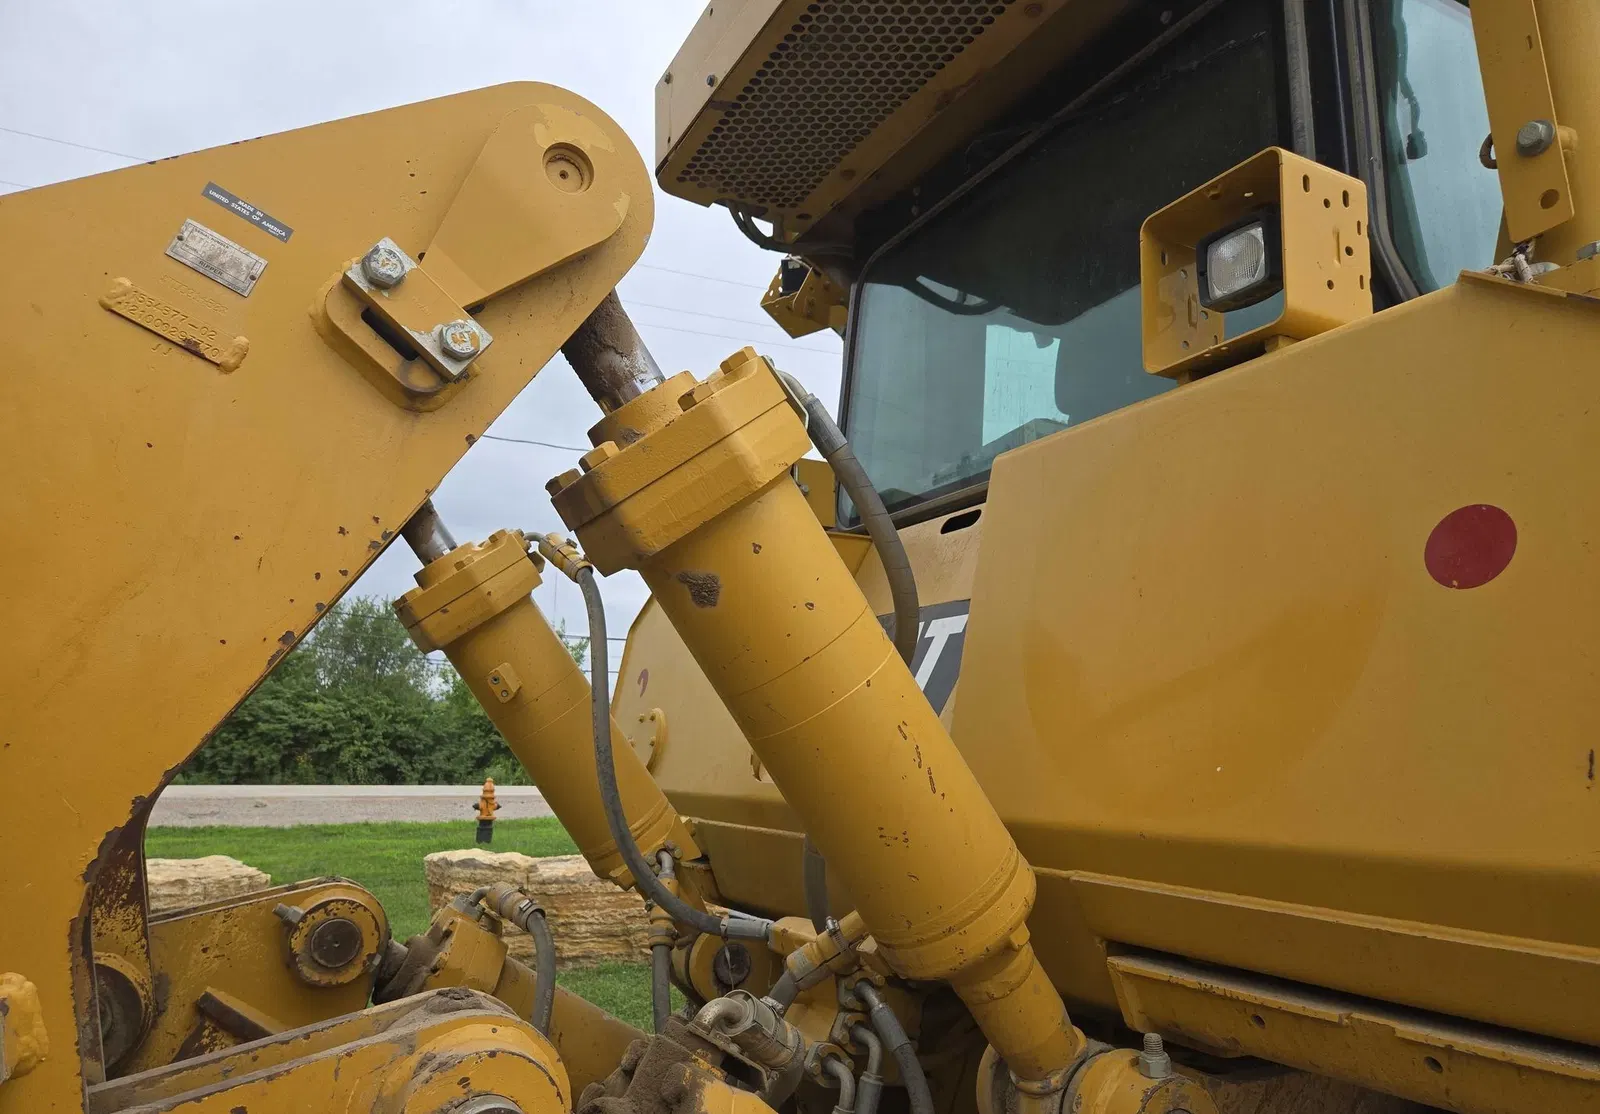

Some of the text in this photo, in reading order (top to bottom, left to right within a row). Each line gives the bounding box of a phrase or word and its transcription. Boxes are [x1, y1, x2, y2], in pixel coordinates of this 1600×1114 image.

[208, 189, 229, 204] UNITED
[230, 202, 251, 217] STATES
[251, 214, 261, 222] OF
[261, 220, 286, 237] AMERICA
[237, 200, 265, 218] MADE IN
[199, 260, 224, 277] RIPPER
